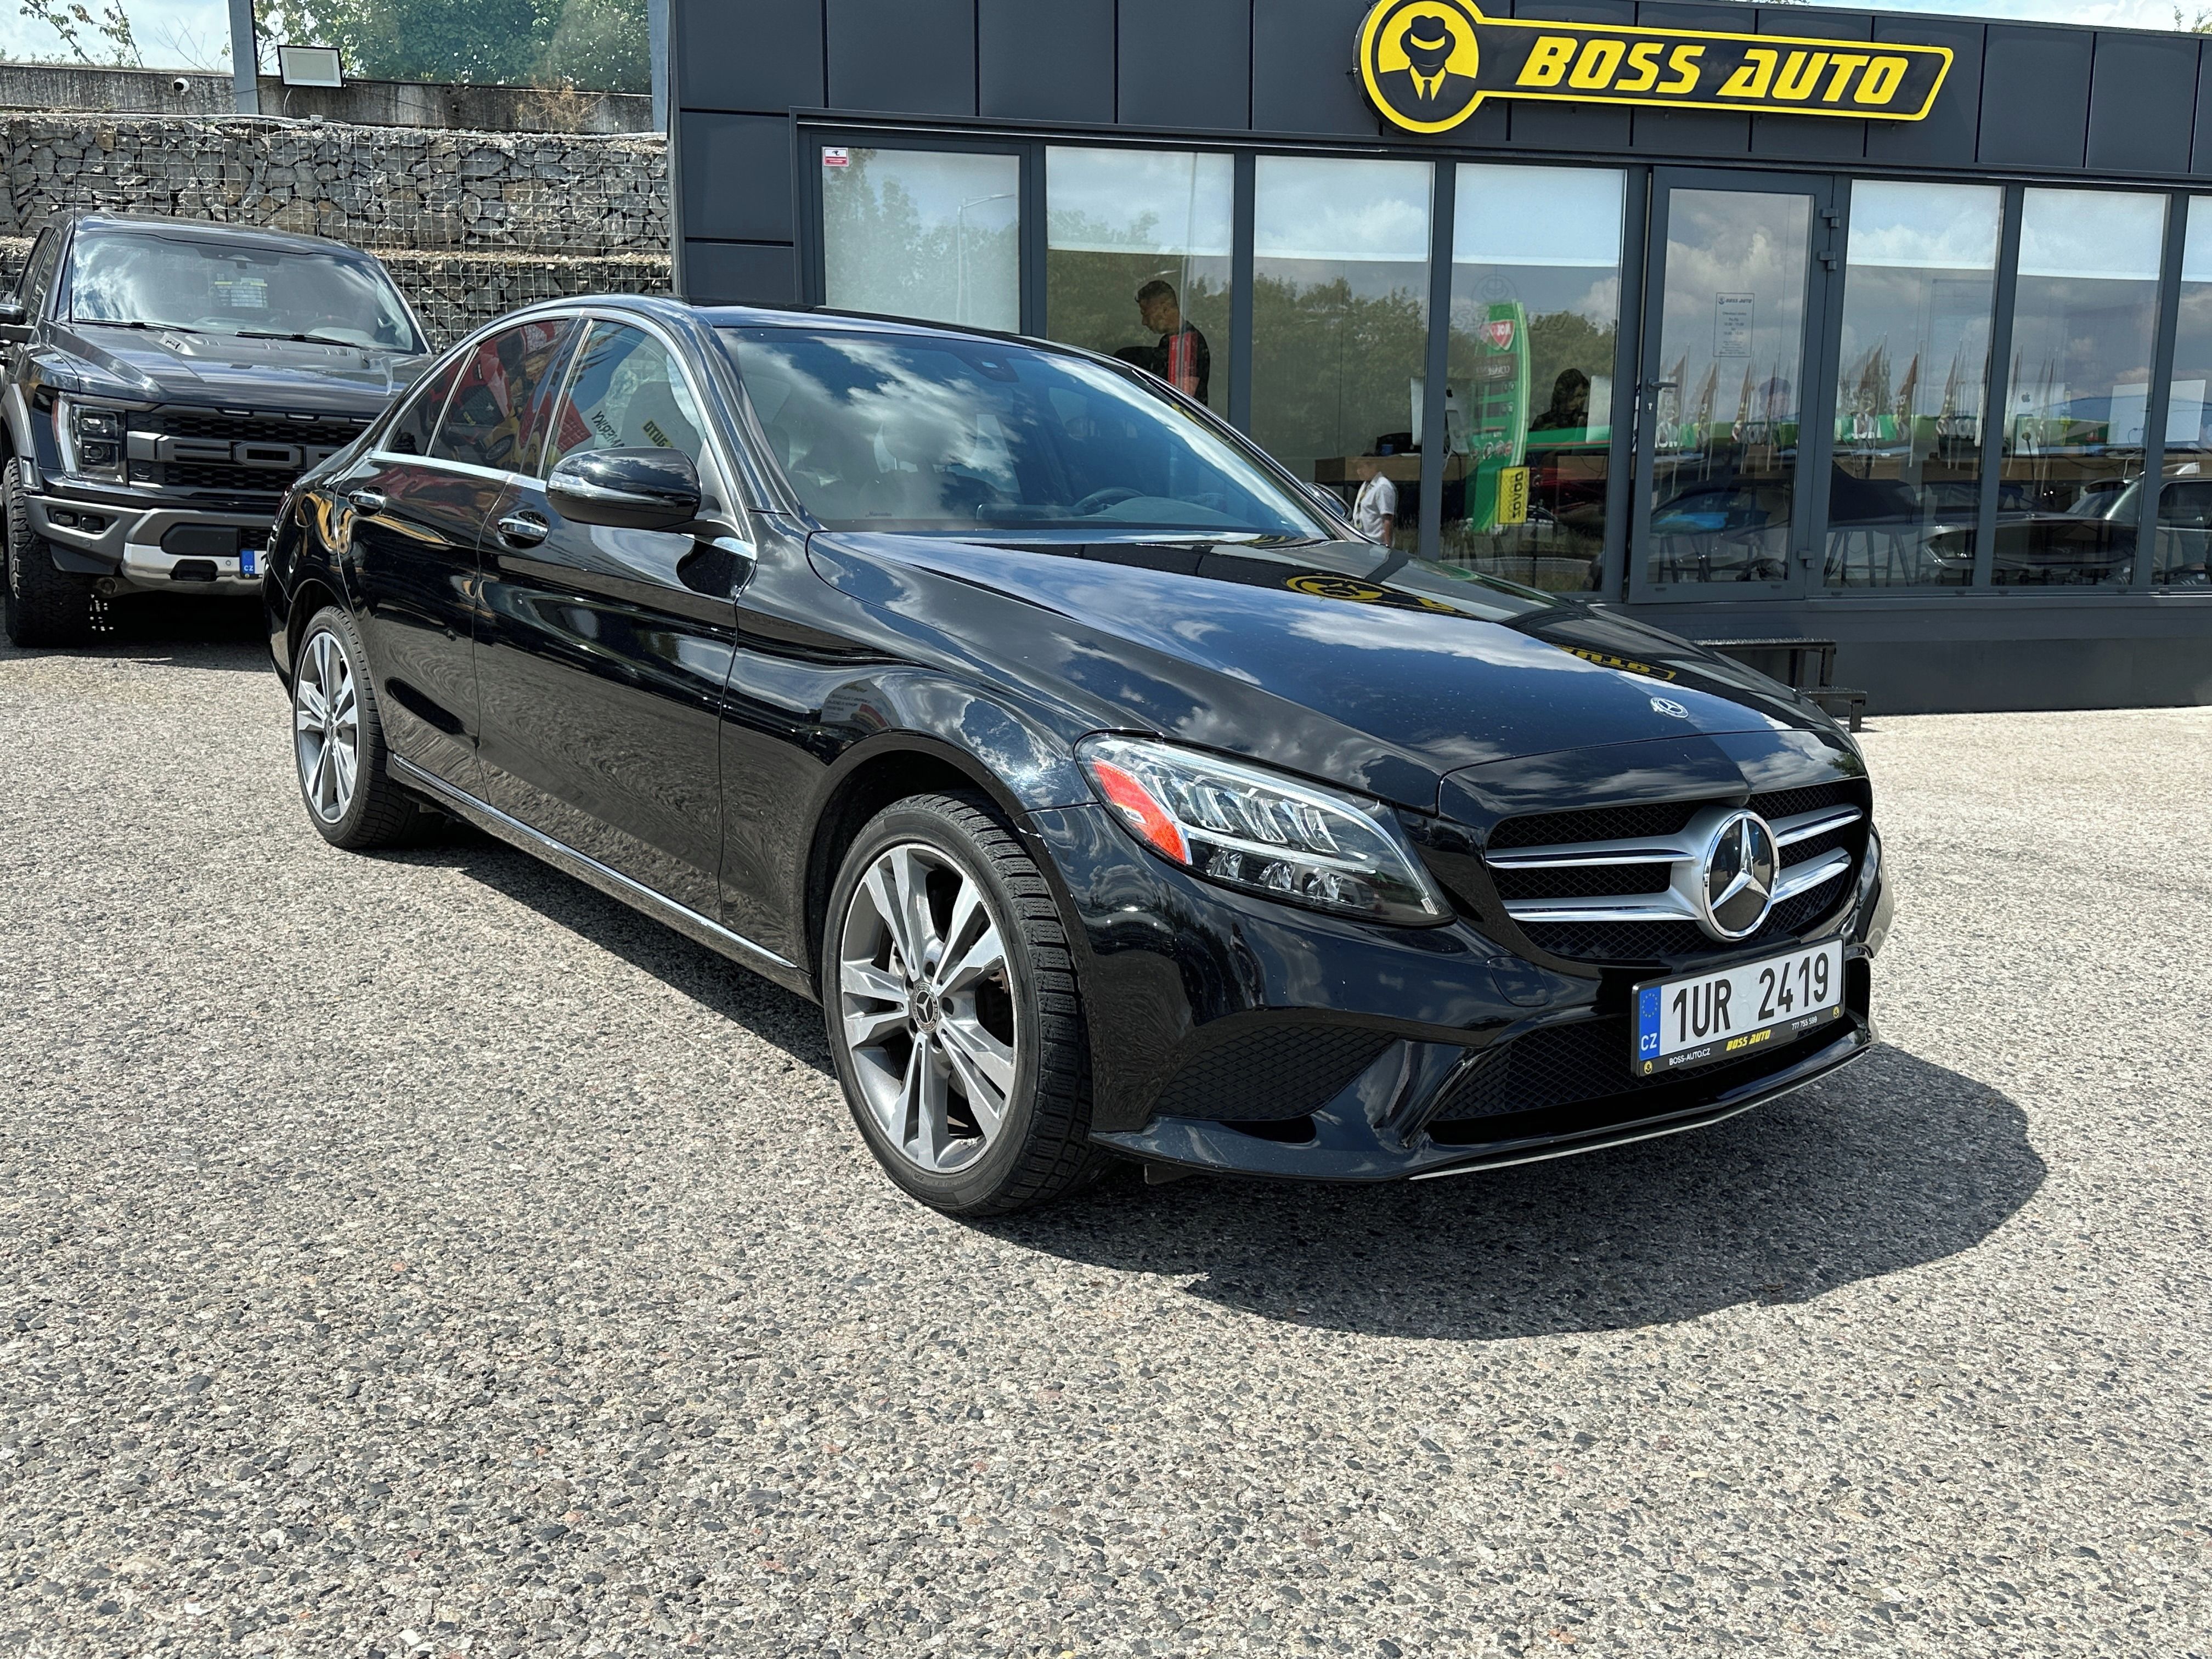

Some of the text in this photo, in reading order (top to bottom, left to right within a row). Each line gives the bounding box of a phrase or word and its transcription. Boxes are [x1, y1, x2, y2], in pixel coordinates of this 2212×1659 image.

[1515, 36, 1909, 104] BOSS AUTO
[1673, 952, 1829, 1042] 1UR 2419
[1640, 1032, 1657, 1051] CZ
[1726, 1029, 1771, 1051] BOSS AUTO
[1669, 1048, 1711, 1066] BOSS-AUTO.CZ
